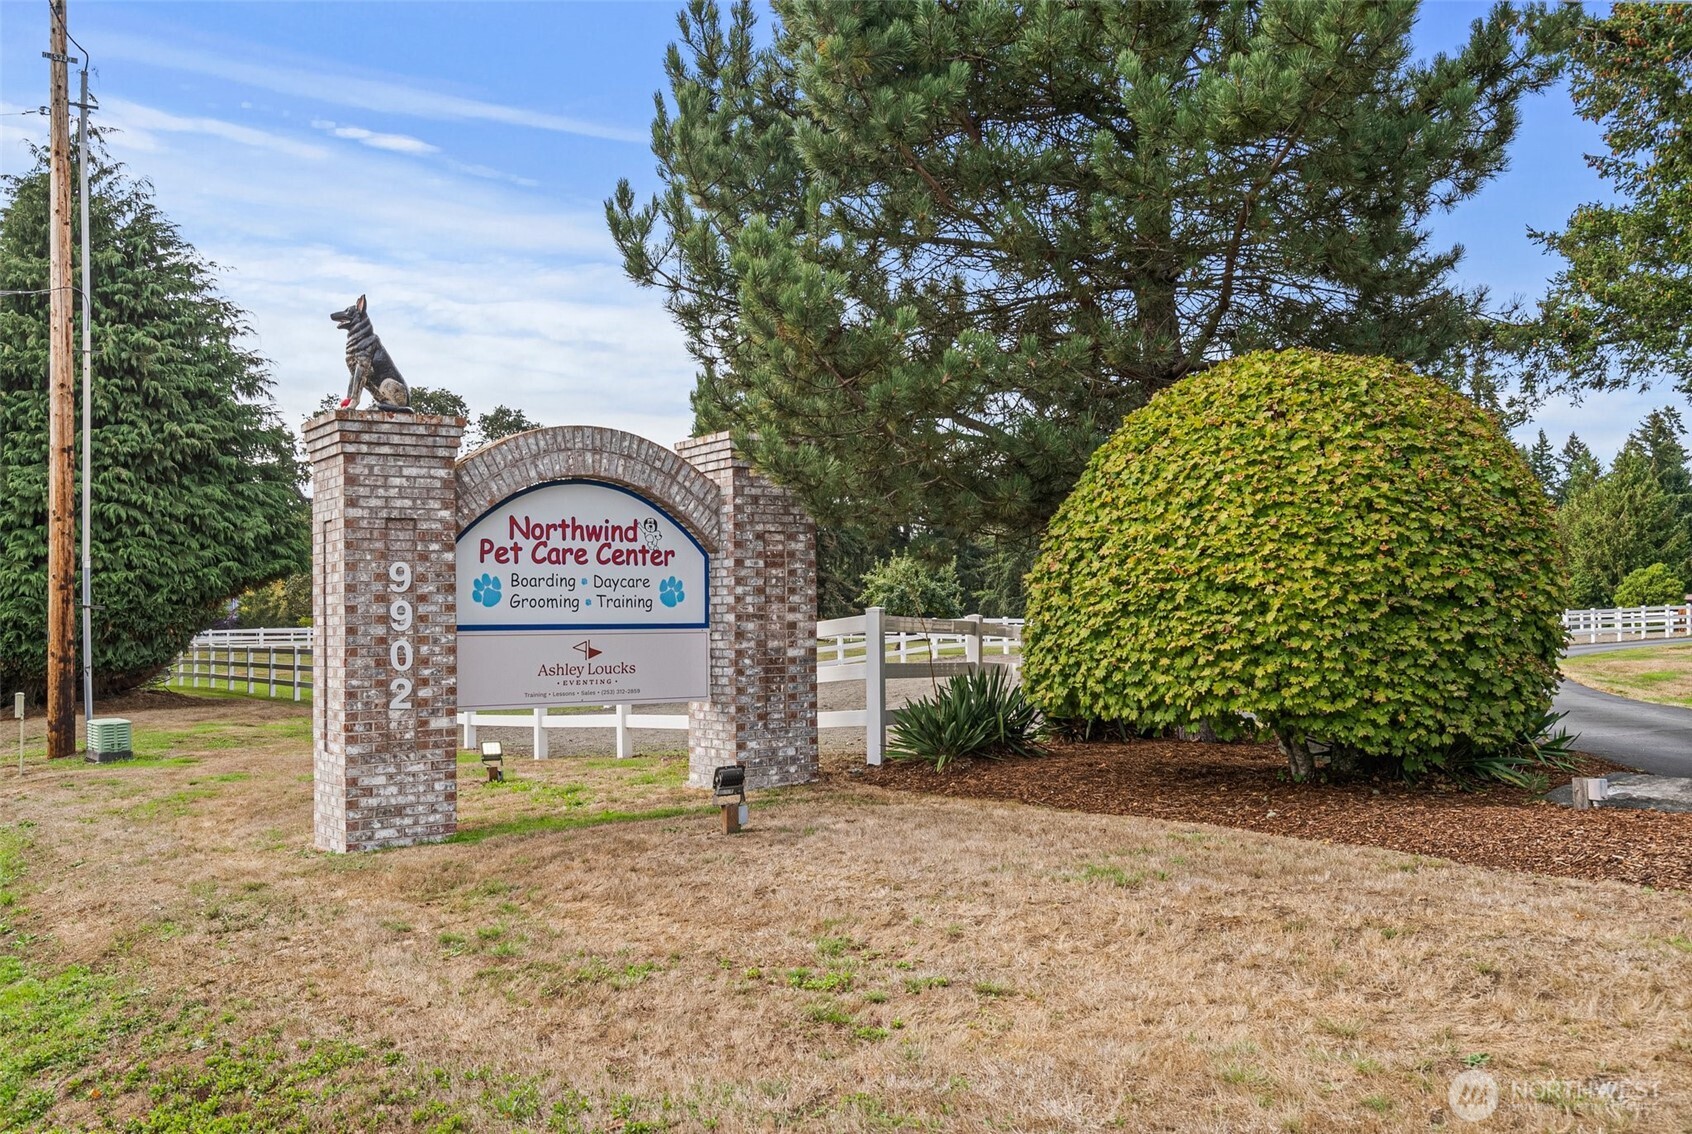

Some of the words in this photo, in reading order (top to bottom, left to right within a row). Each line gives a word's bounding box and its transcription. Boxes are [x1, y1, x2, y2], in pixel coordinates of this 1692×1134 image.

[509, 515, 638, 542] Northwind
[479, 538, 523, 564] Pet
[531, 540, 589, 565] Care
[595, 542, 675, 566] Center
[510, 573, 576, 592] Boarding
[593, 574, 650, 589] Daycare
[509, 594, 579, 612] Grooming
[596, 594, 653, 612] Training
[389, 561, 413, 710] 9902
[537, 663, 584, 678] Ashley
[587, 661, 636, 675] Loucks
